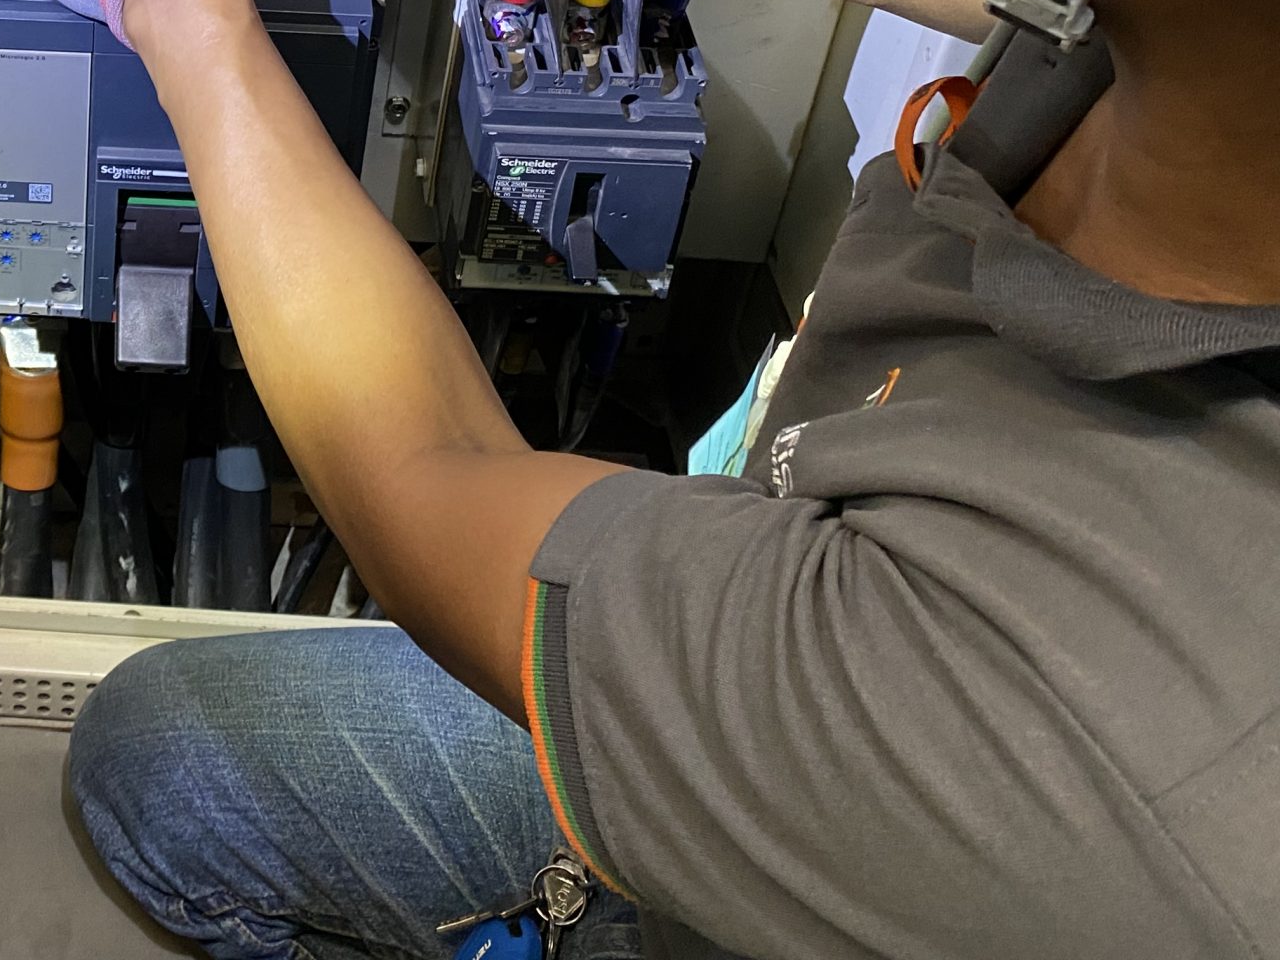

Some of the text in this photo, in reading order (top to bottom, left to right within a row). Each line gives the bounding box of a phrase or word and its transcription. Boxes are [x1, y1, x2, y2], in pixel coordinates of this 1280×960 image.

[501, 158, 558, 168] Schneider
[100, 165, 152, 176] Schneider
[525, 167, 556, 175] Electric
